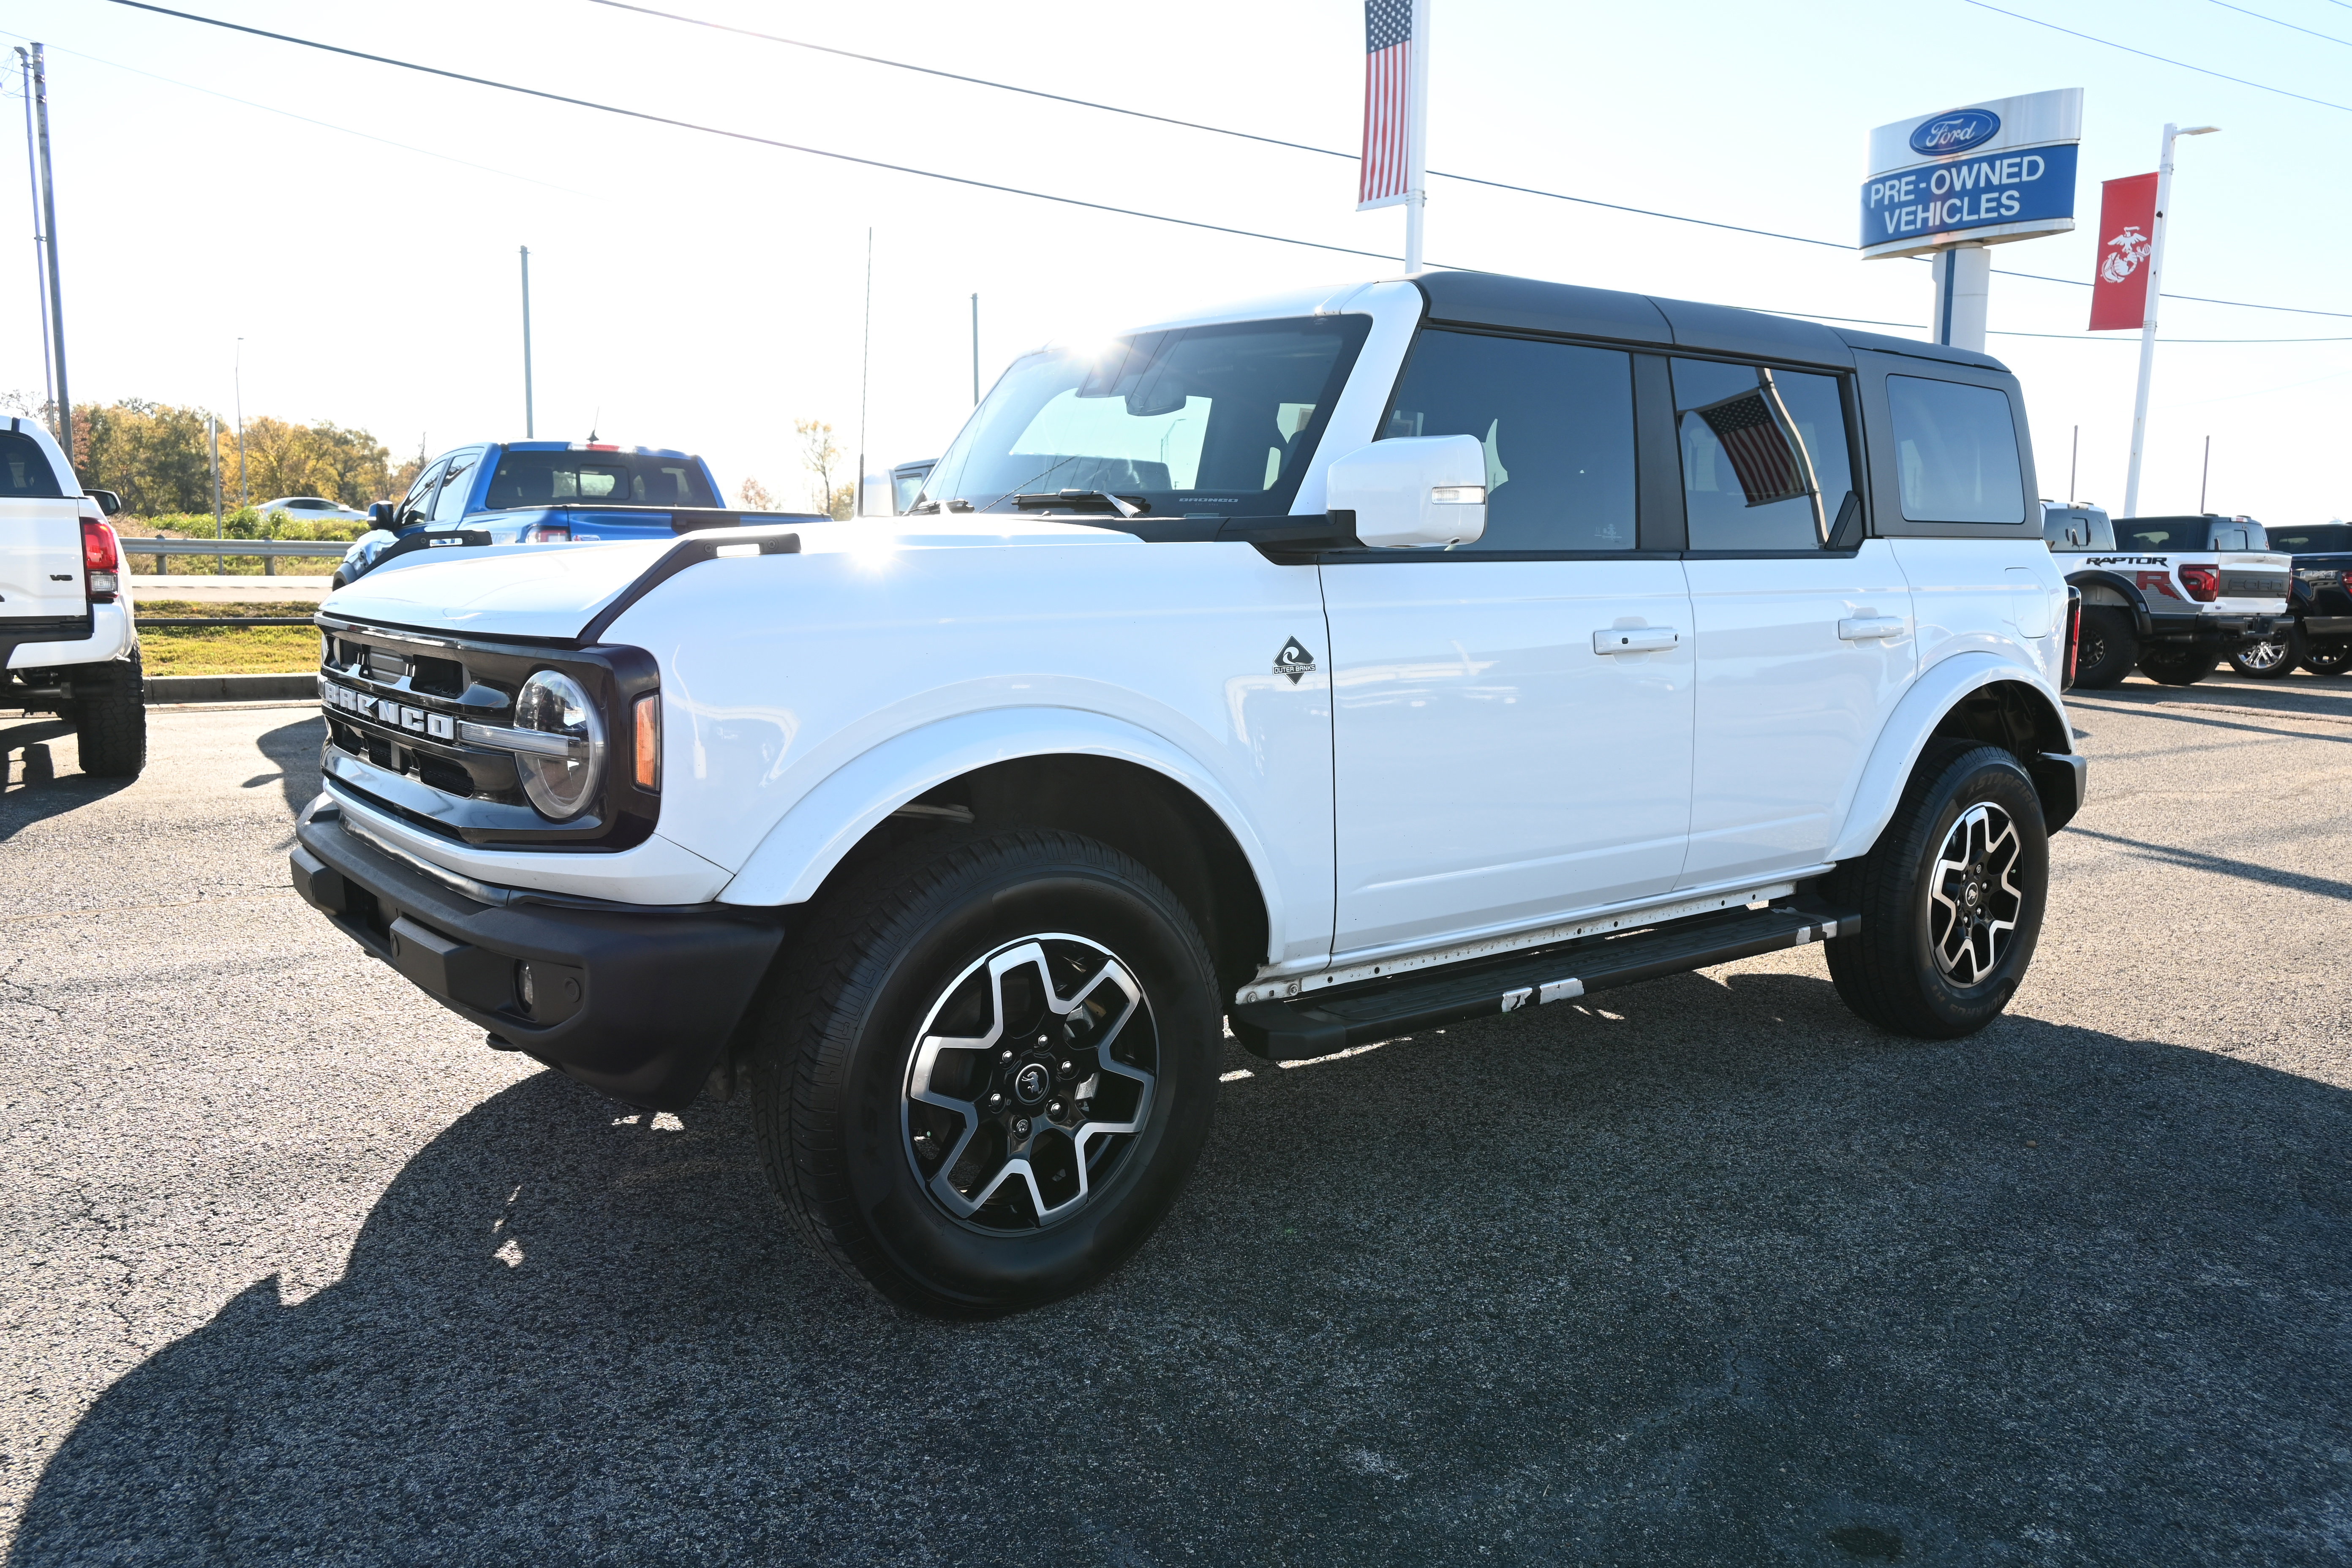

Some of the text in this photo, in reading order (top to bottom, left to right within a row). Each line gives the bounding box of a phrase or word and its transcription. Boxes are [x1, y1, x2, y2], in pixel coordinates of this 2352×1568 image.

[1926, 118, 1976, 147] Ford
[1870, 155, 2045, 208] PRE-OWNED
[1884, 190, 2020, 234] VEHICLES
[2086, 557, 2169, 568] RAPTOR
[2228, 579, 2284, 590] FORD
[325, 681, 454, 740] BRONCO
[1976, 772, 2039, 814] STARFIRE
[1948, 988, 2006, 1017] SOLARUS
